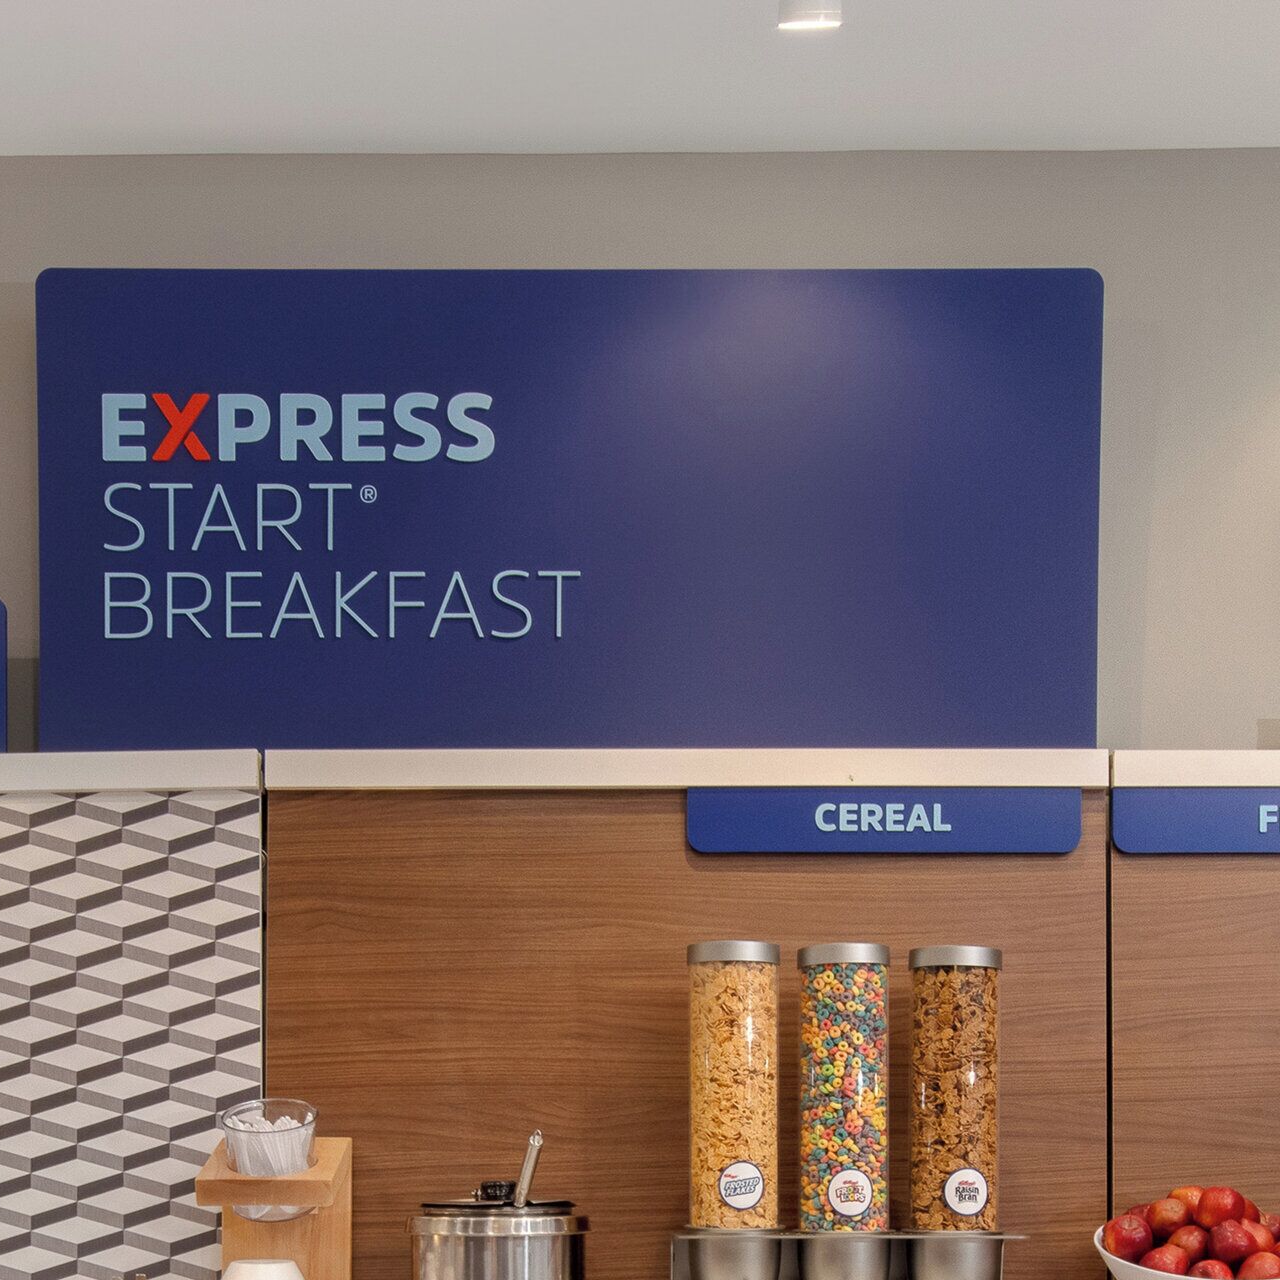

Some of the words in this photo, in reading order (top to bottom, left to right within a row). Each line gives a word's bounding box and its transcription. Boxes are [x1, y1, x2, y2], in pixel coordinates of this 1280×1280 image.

[101, 392, 496, 462] EXPRESS
[104, 569, 582, 639] BREAKFAST
[814, 803, 952, 832] CEREAL
[724, 1177, 760, 1191] FROSTED
[955, 1186, 979, 1195] Raisin
[958, 1193, 977, 1202] Bran
